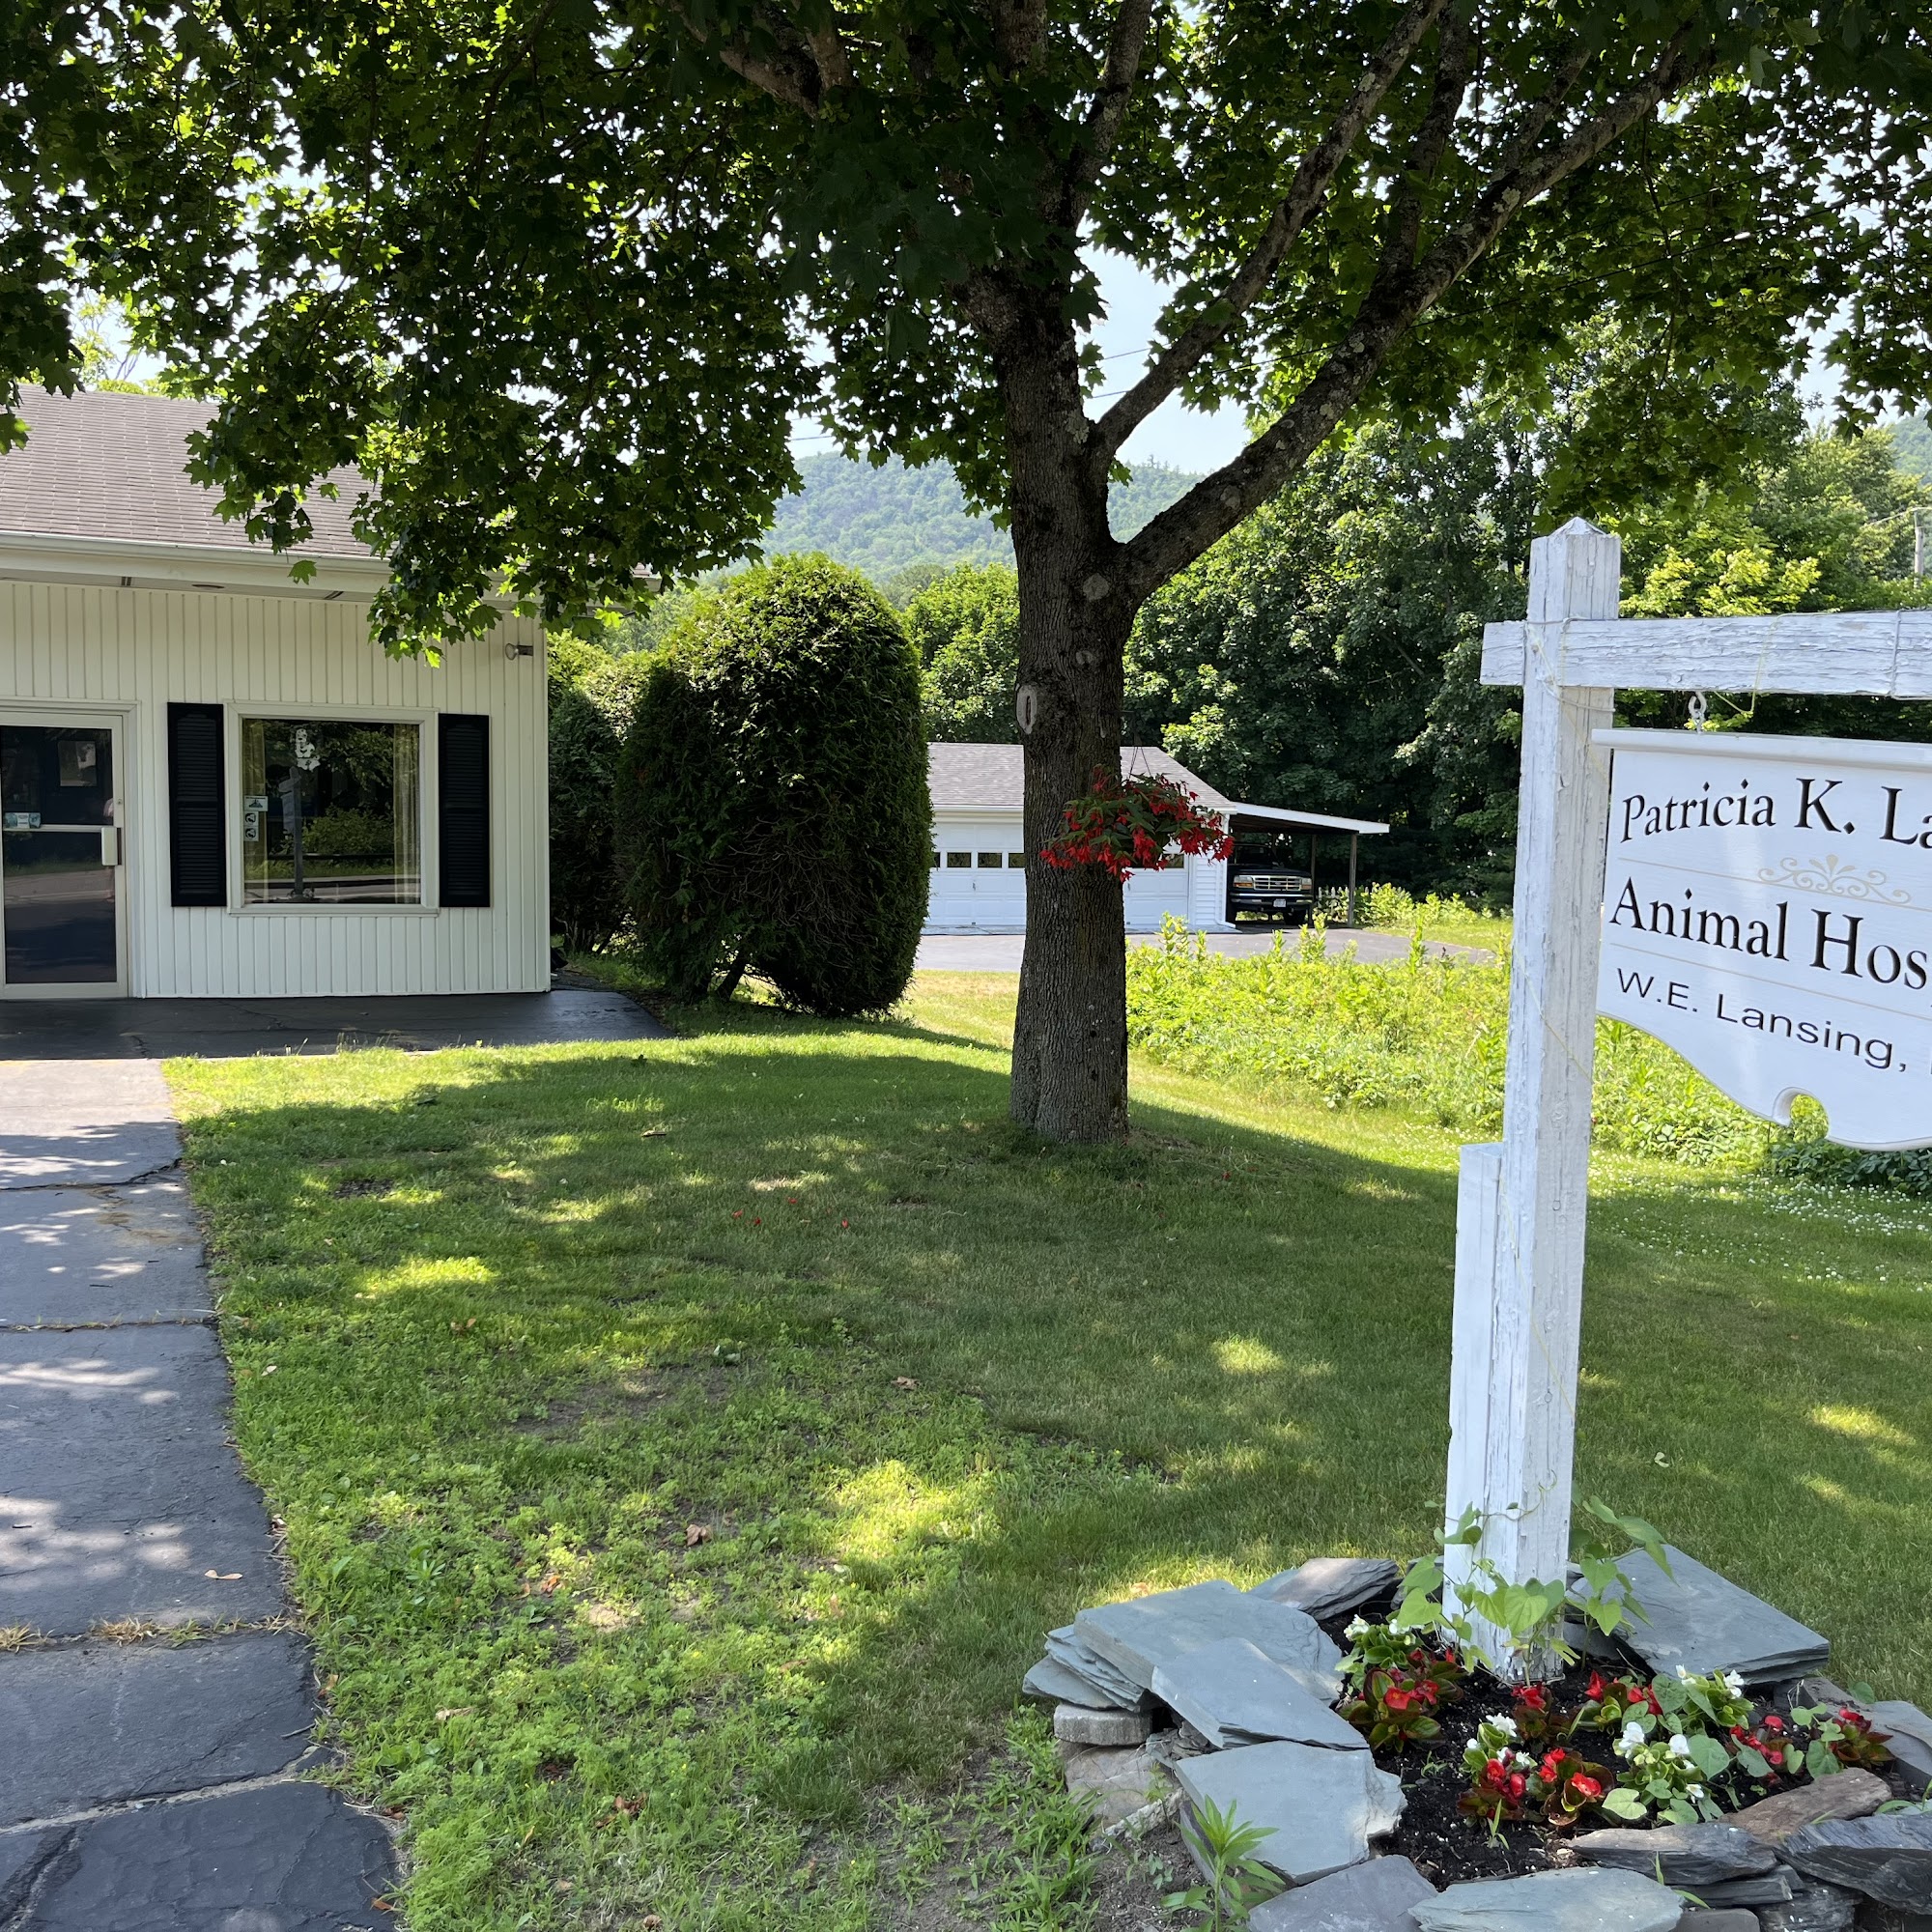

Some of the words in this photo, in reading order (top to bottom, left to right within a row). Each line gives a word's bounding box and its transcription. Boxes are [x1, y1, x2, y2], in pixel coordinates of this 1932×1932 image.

[1619, 779, 1776, 843] Patricia
[1793, 777, 1856, 835] K.
[1608, 875, 1791, 962] Animal
[1808, 908, 1928, 990] Hos
[1616, 967, 1699, 1013] W.E.
[1716, 992, 1908, 1073] Lansing,
